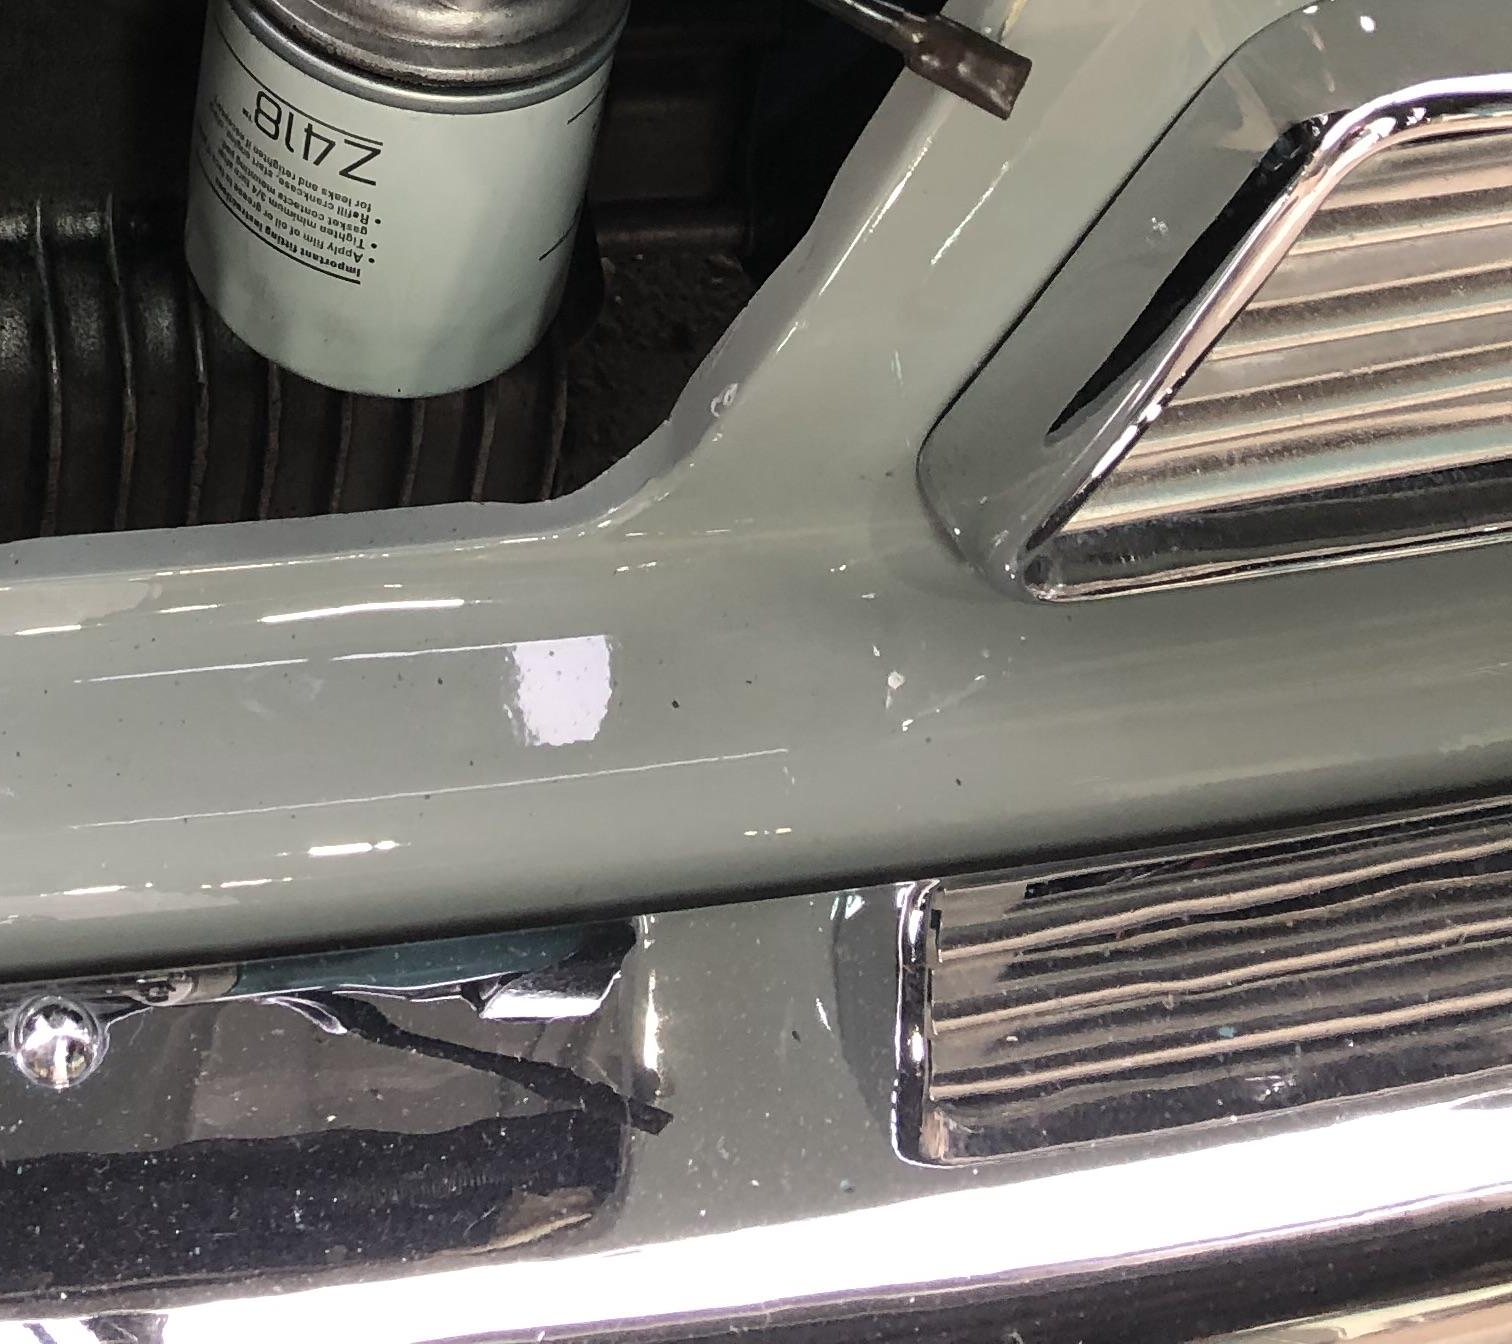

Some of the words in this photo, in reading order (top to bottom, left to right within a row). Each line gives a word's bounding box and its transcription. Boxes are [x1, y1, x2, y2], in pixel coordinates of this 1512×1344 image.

[253, 145, 295, 180] retighten
[251, 184, 265, 201] 3/4
[299, 175, 317, 192] and
[276, 191, 324, 221] contacts
[319, 187, 351, 207] leaks
[353, 199, 371, 213] for
[267, 196, 316, 229] minimum
[274, 217, 287, 229] oil
[335, 204, 369, 225] Refill
[289, 225, 299, 236] of
[327, 215, 366, 236] gasket
[264, 224, 296, 254] fitting
[301, 231, 323, 250] film
[318, 224, 364, 250] Tighten
[300, 246, 360, 278] Important
[325, 241, 364, 263] Apply
